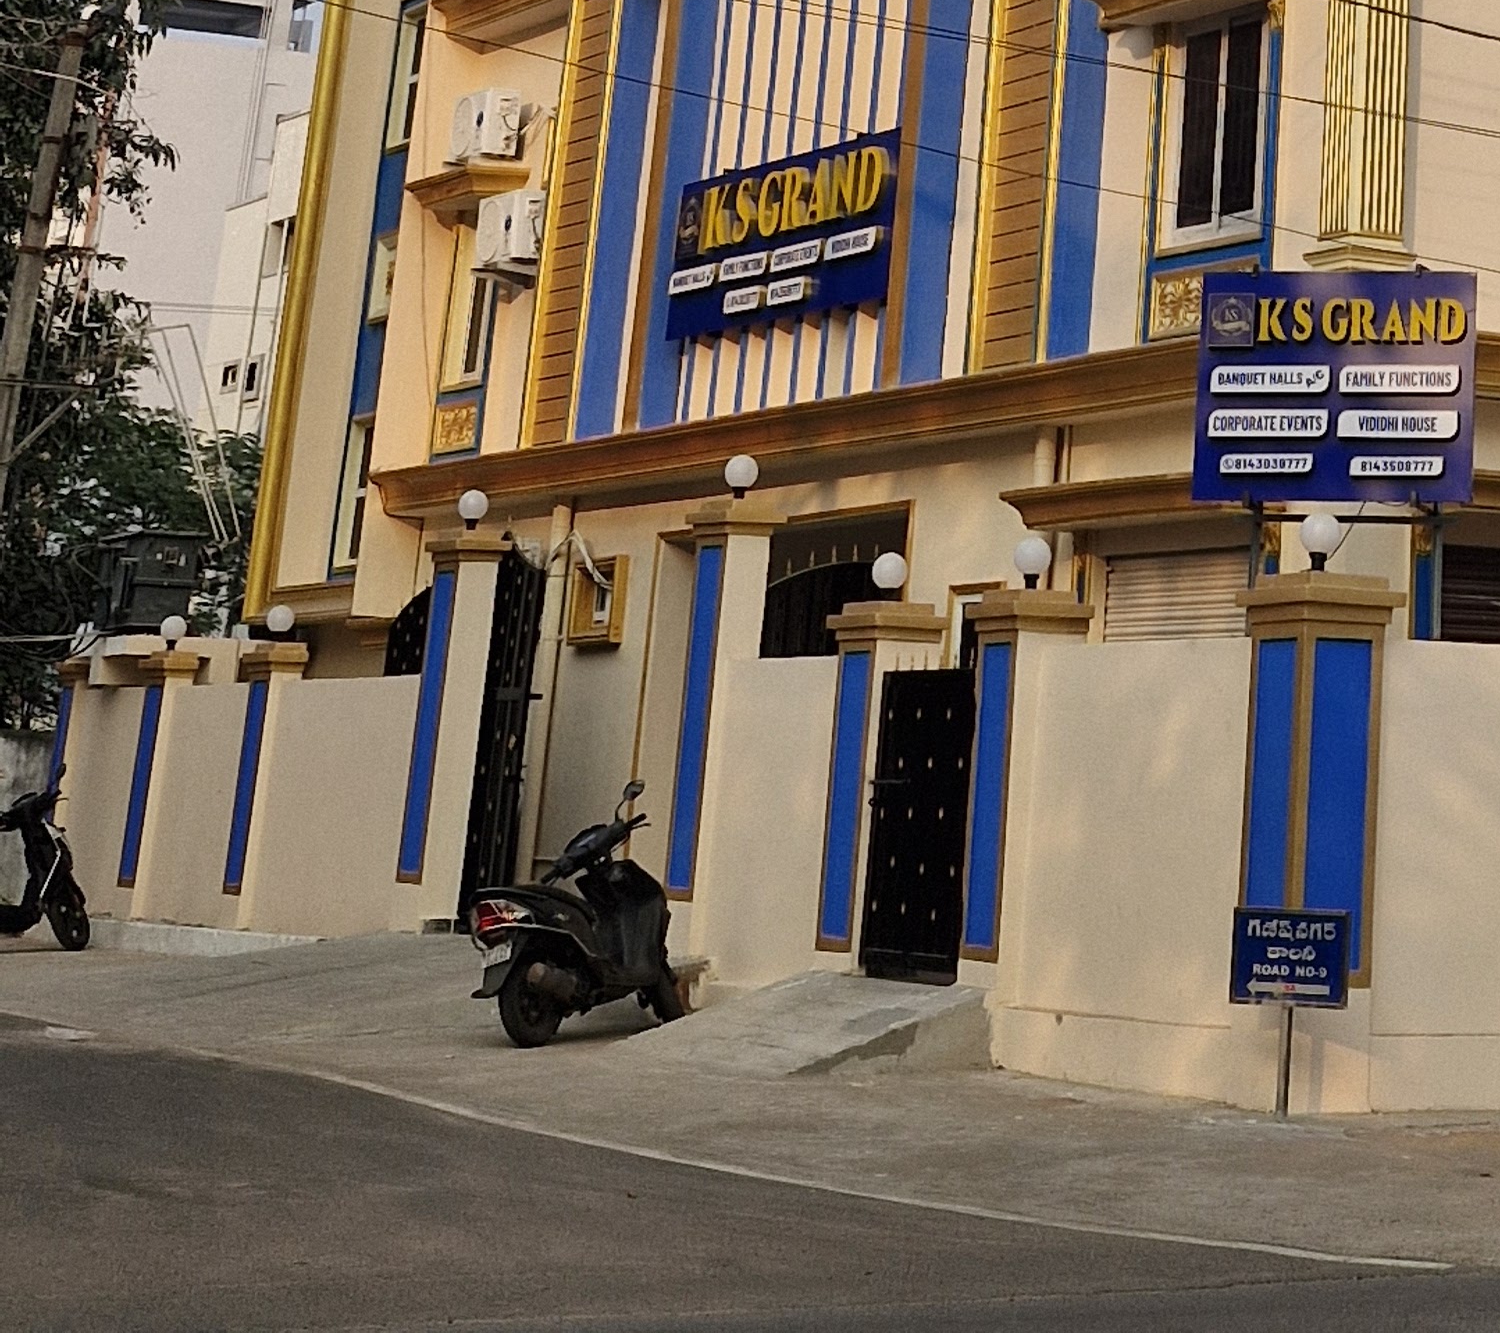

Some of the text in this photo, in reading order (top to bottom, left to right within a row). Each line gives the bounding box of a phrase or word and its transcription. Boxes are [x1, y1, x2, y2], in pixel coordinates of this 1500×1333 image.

[1321, 296, 1468, 345] GRAND
[1345, 372, 1453, 387] FAMILY FUNCTIONS
[1212, 415, 1323, 432] CORPORATE EVENTS
[1401, 416, 1438, 433] HOUSE
[1252, 964, 1327, 978] ROAD NO-9
